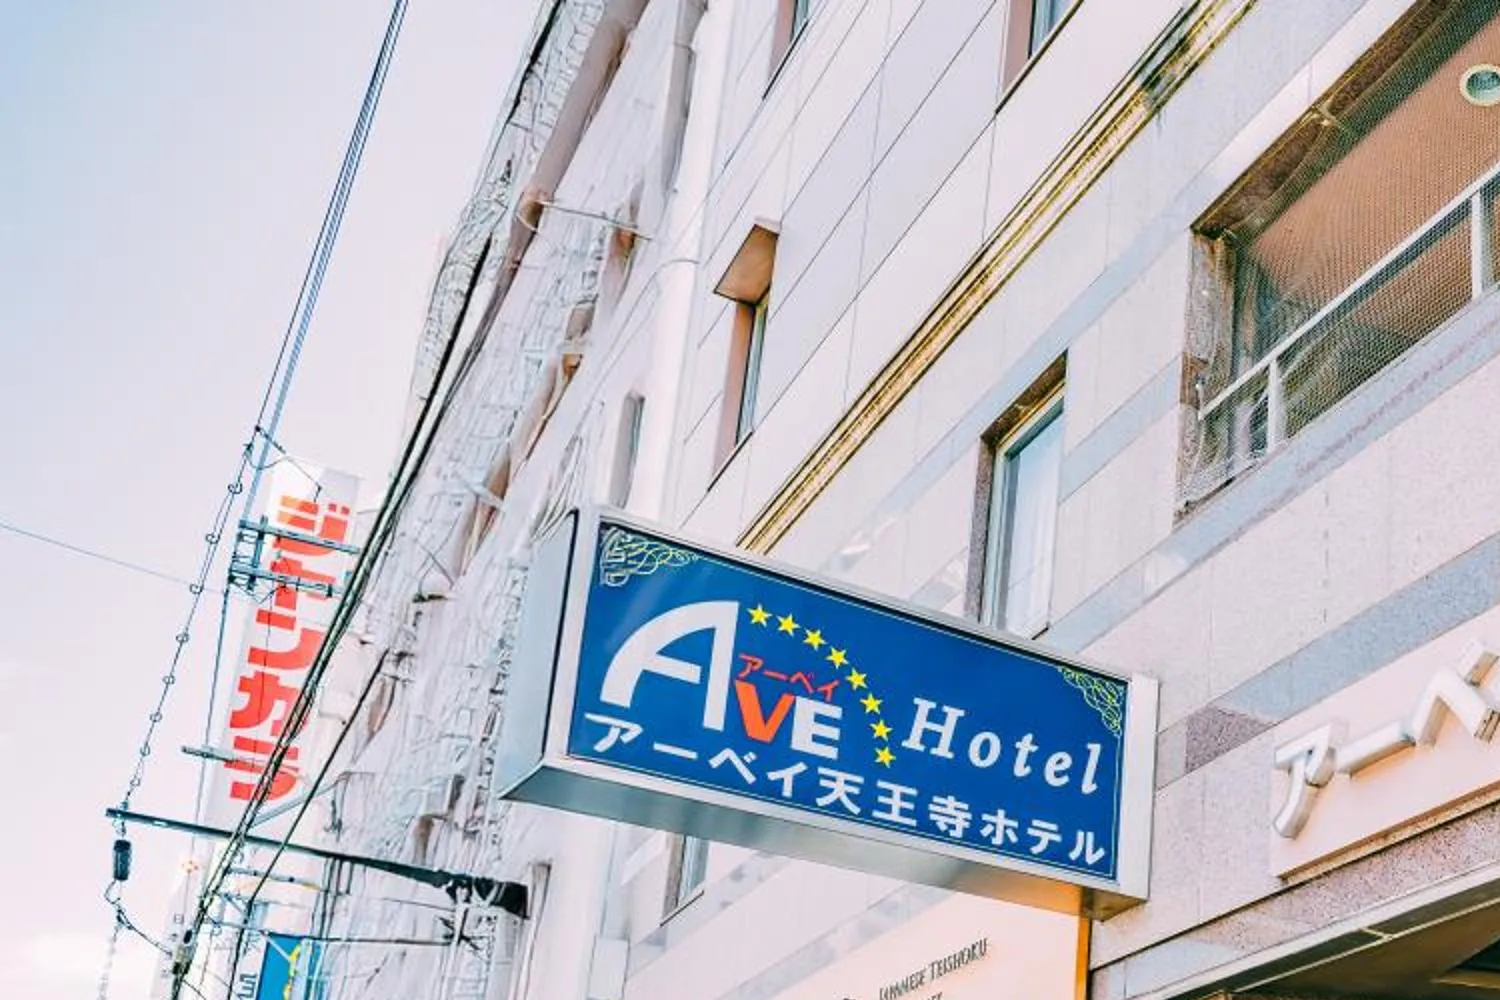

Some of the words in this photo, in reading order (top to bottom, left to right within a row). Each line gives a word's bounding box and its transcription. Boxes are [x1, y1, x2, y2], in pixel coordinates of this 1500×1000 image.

[736, 653, 841, 701] アーベイ
[902, 697, 1103, 796] Hotel
[584, 711, 1106, 866] アーベイ天王寺ホテル
[929, 937, 988, 981] TEISHOKU
